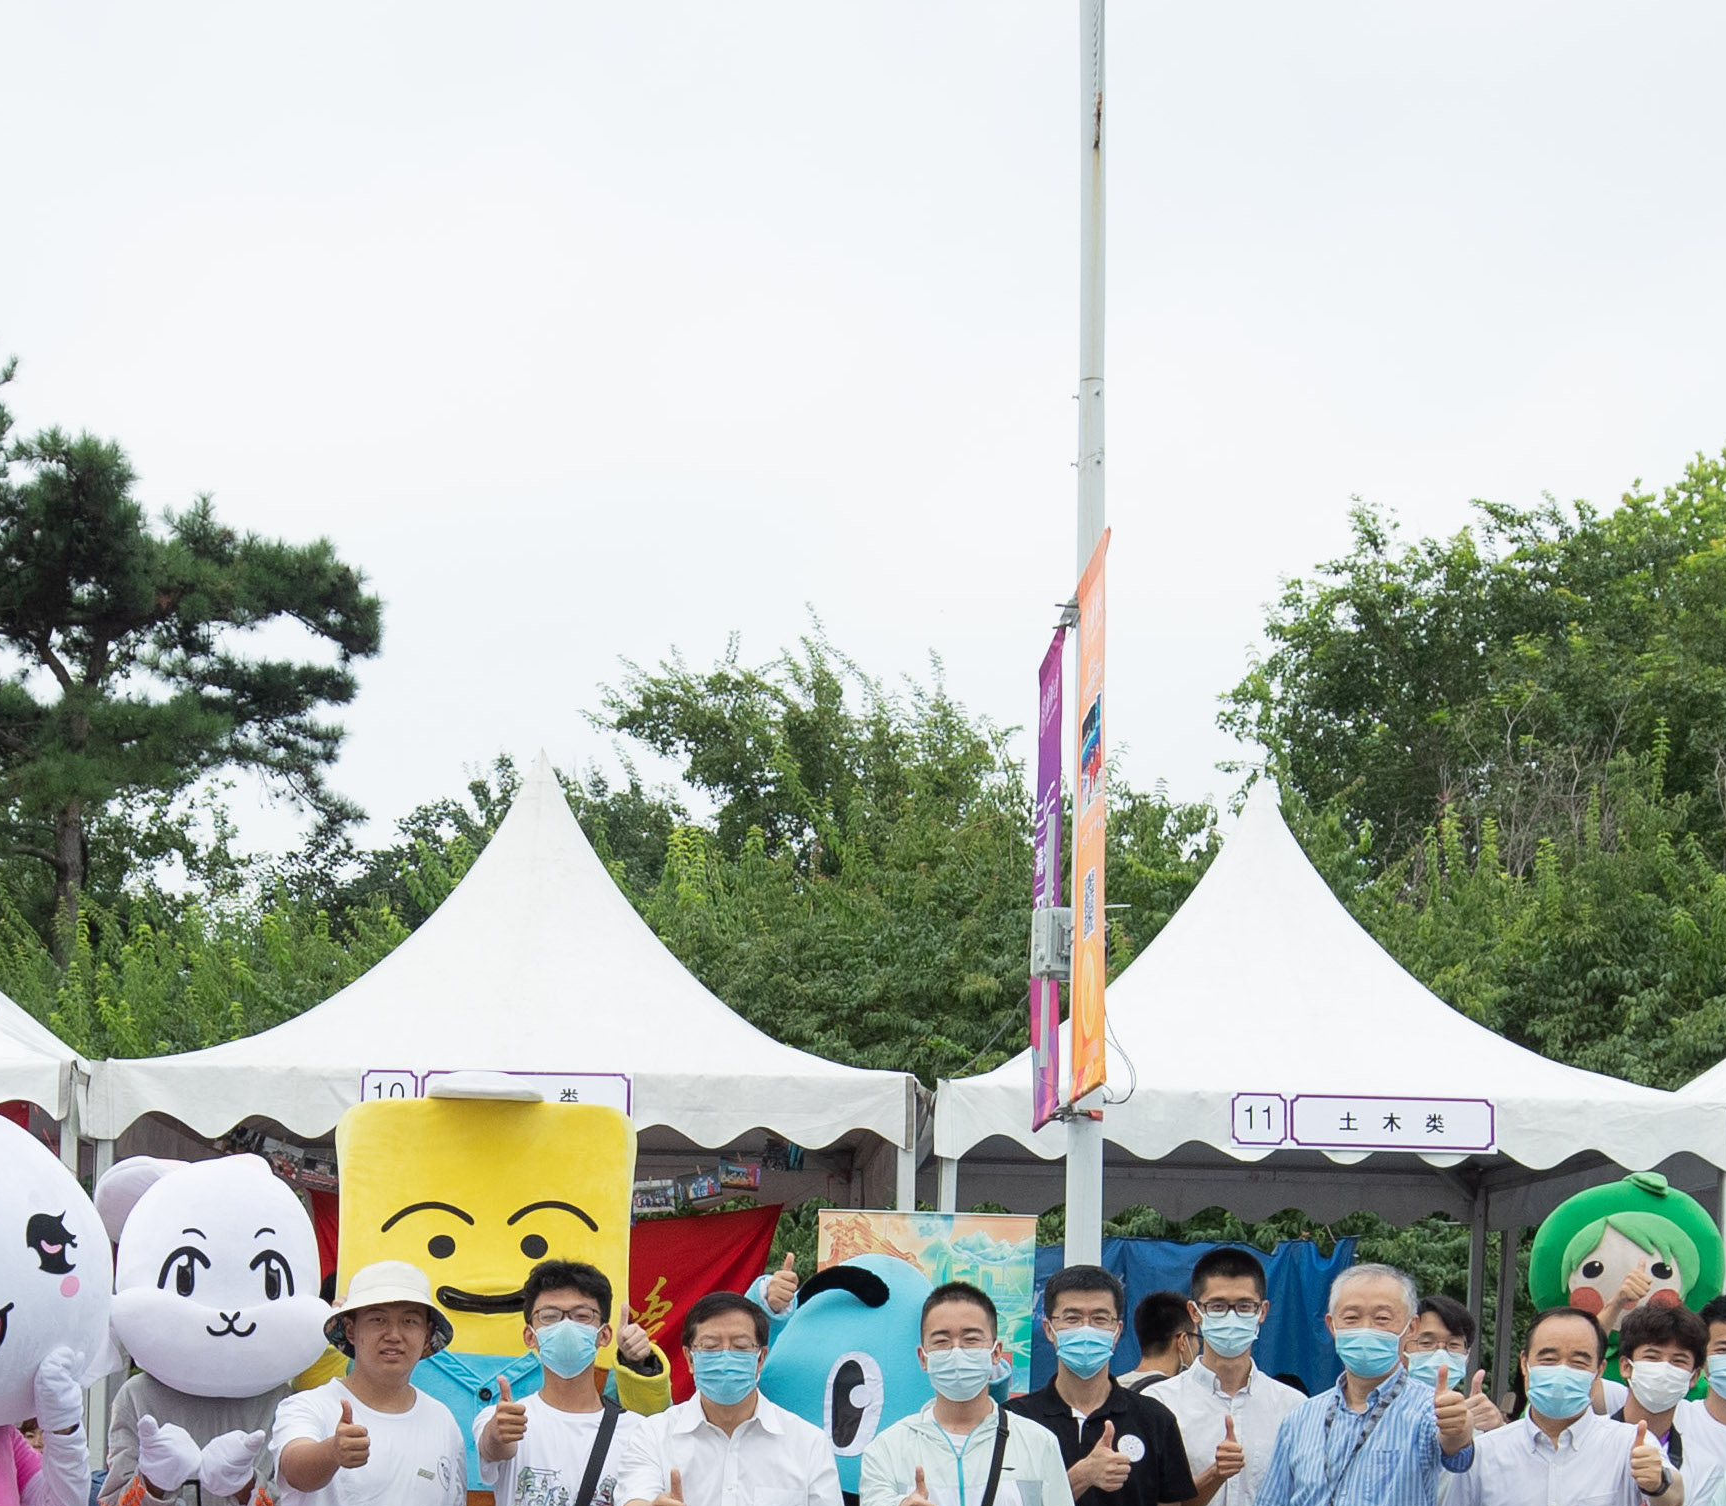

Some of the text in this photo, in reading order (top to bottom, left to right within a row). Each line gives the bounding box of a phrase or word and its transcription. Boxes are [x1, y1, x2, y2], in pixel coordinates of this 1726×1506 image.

[373, 1081, 405, 1098] 10
[1244, 1105, 1272, 1130] 11
[1339, 1111, 1445, 1134] 土木类
